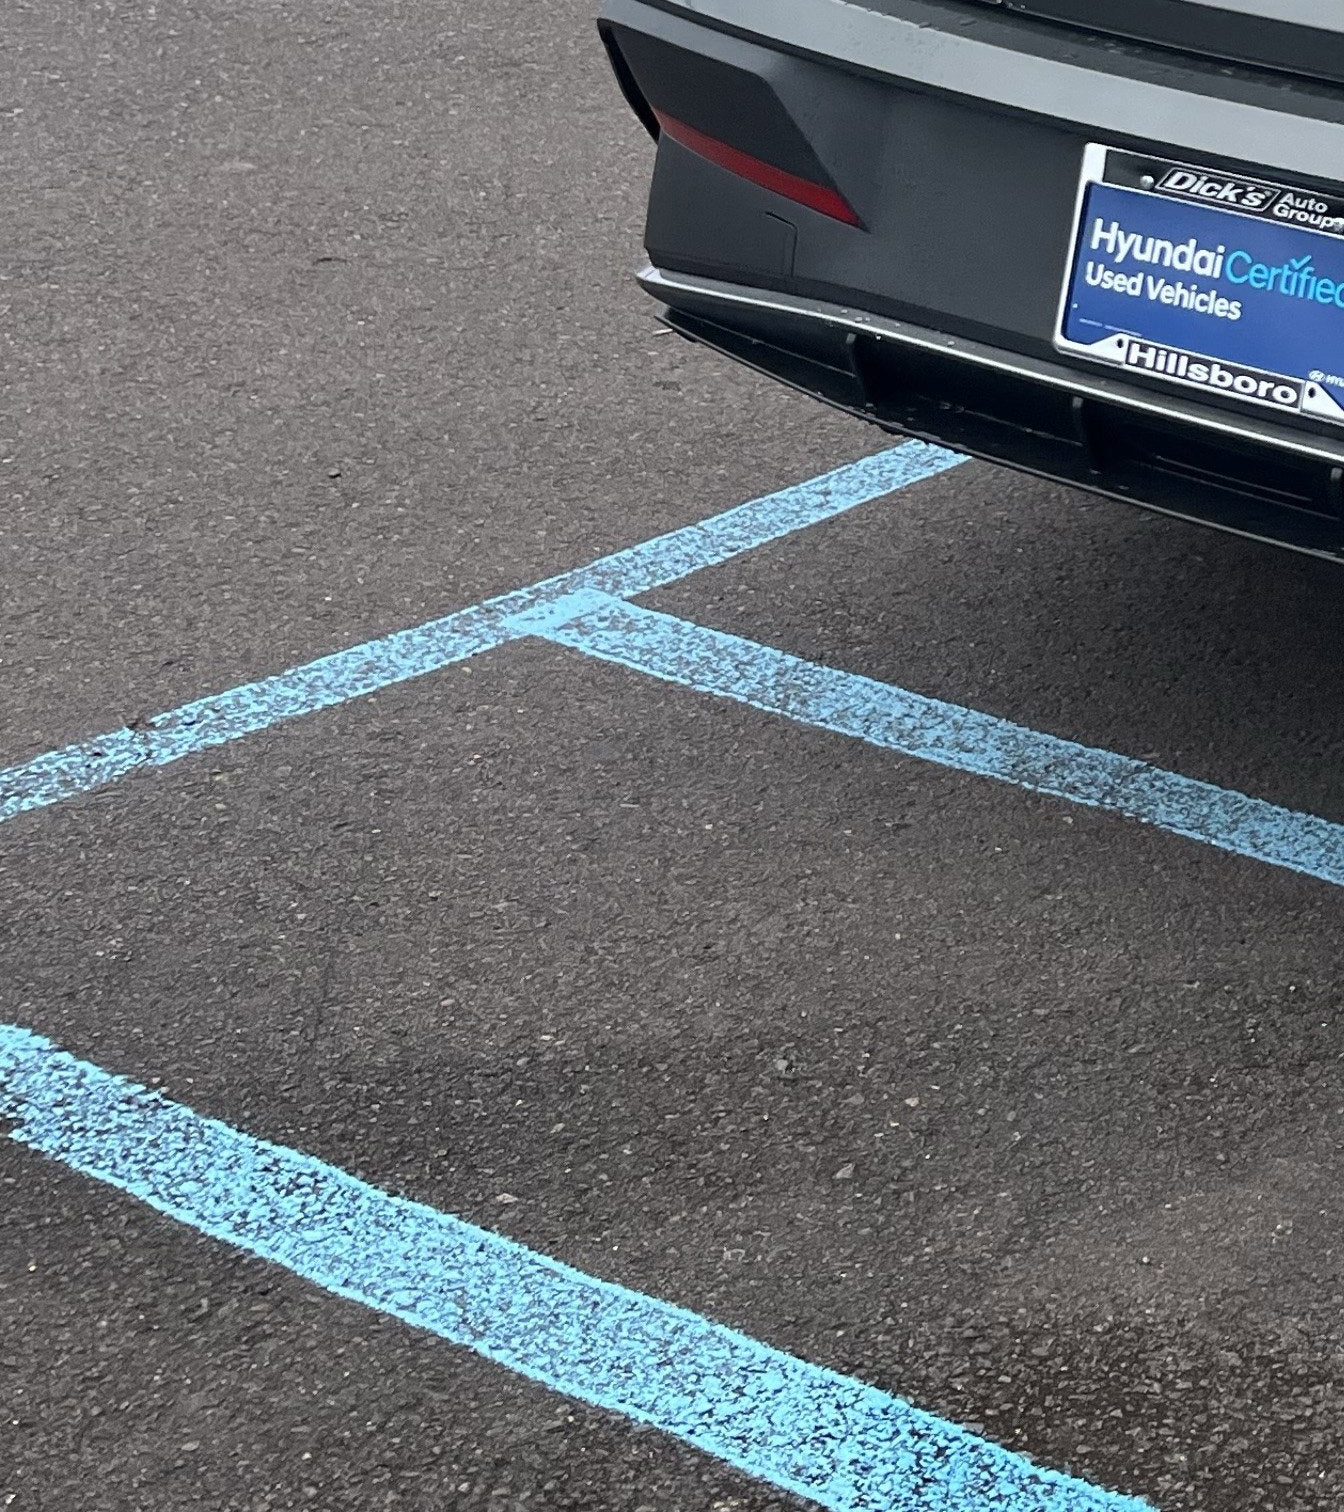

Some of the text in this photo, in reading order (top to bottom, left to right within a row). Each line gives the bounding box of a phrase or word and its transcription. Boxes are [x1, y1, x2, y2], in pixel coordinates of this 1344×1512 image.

[1163, 170, 1268, 208] Dick's
[1279, 192, 1328, 214] Auto
[1272, 203, 1336, 229] Group
[1089, 217, 1226, 279] Hyundai
[1085, 260, 1243, 321] Used Vehicles
[1128, 341, 1299, 405] Hillsboro
